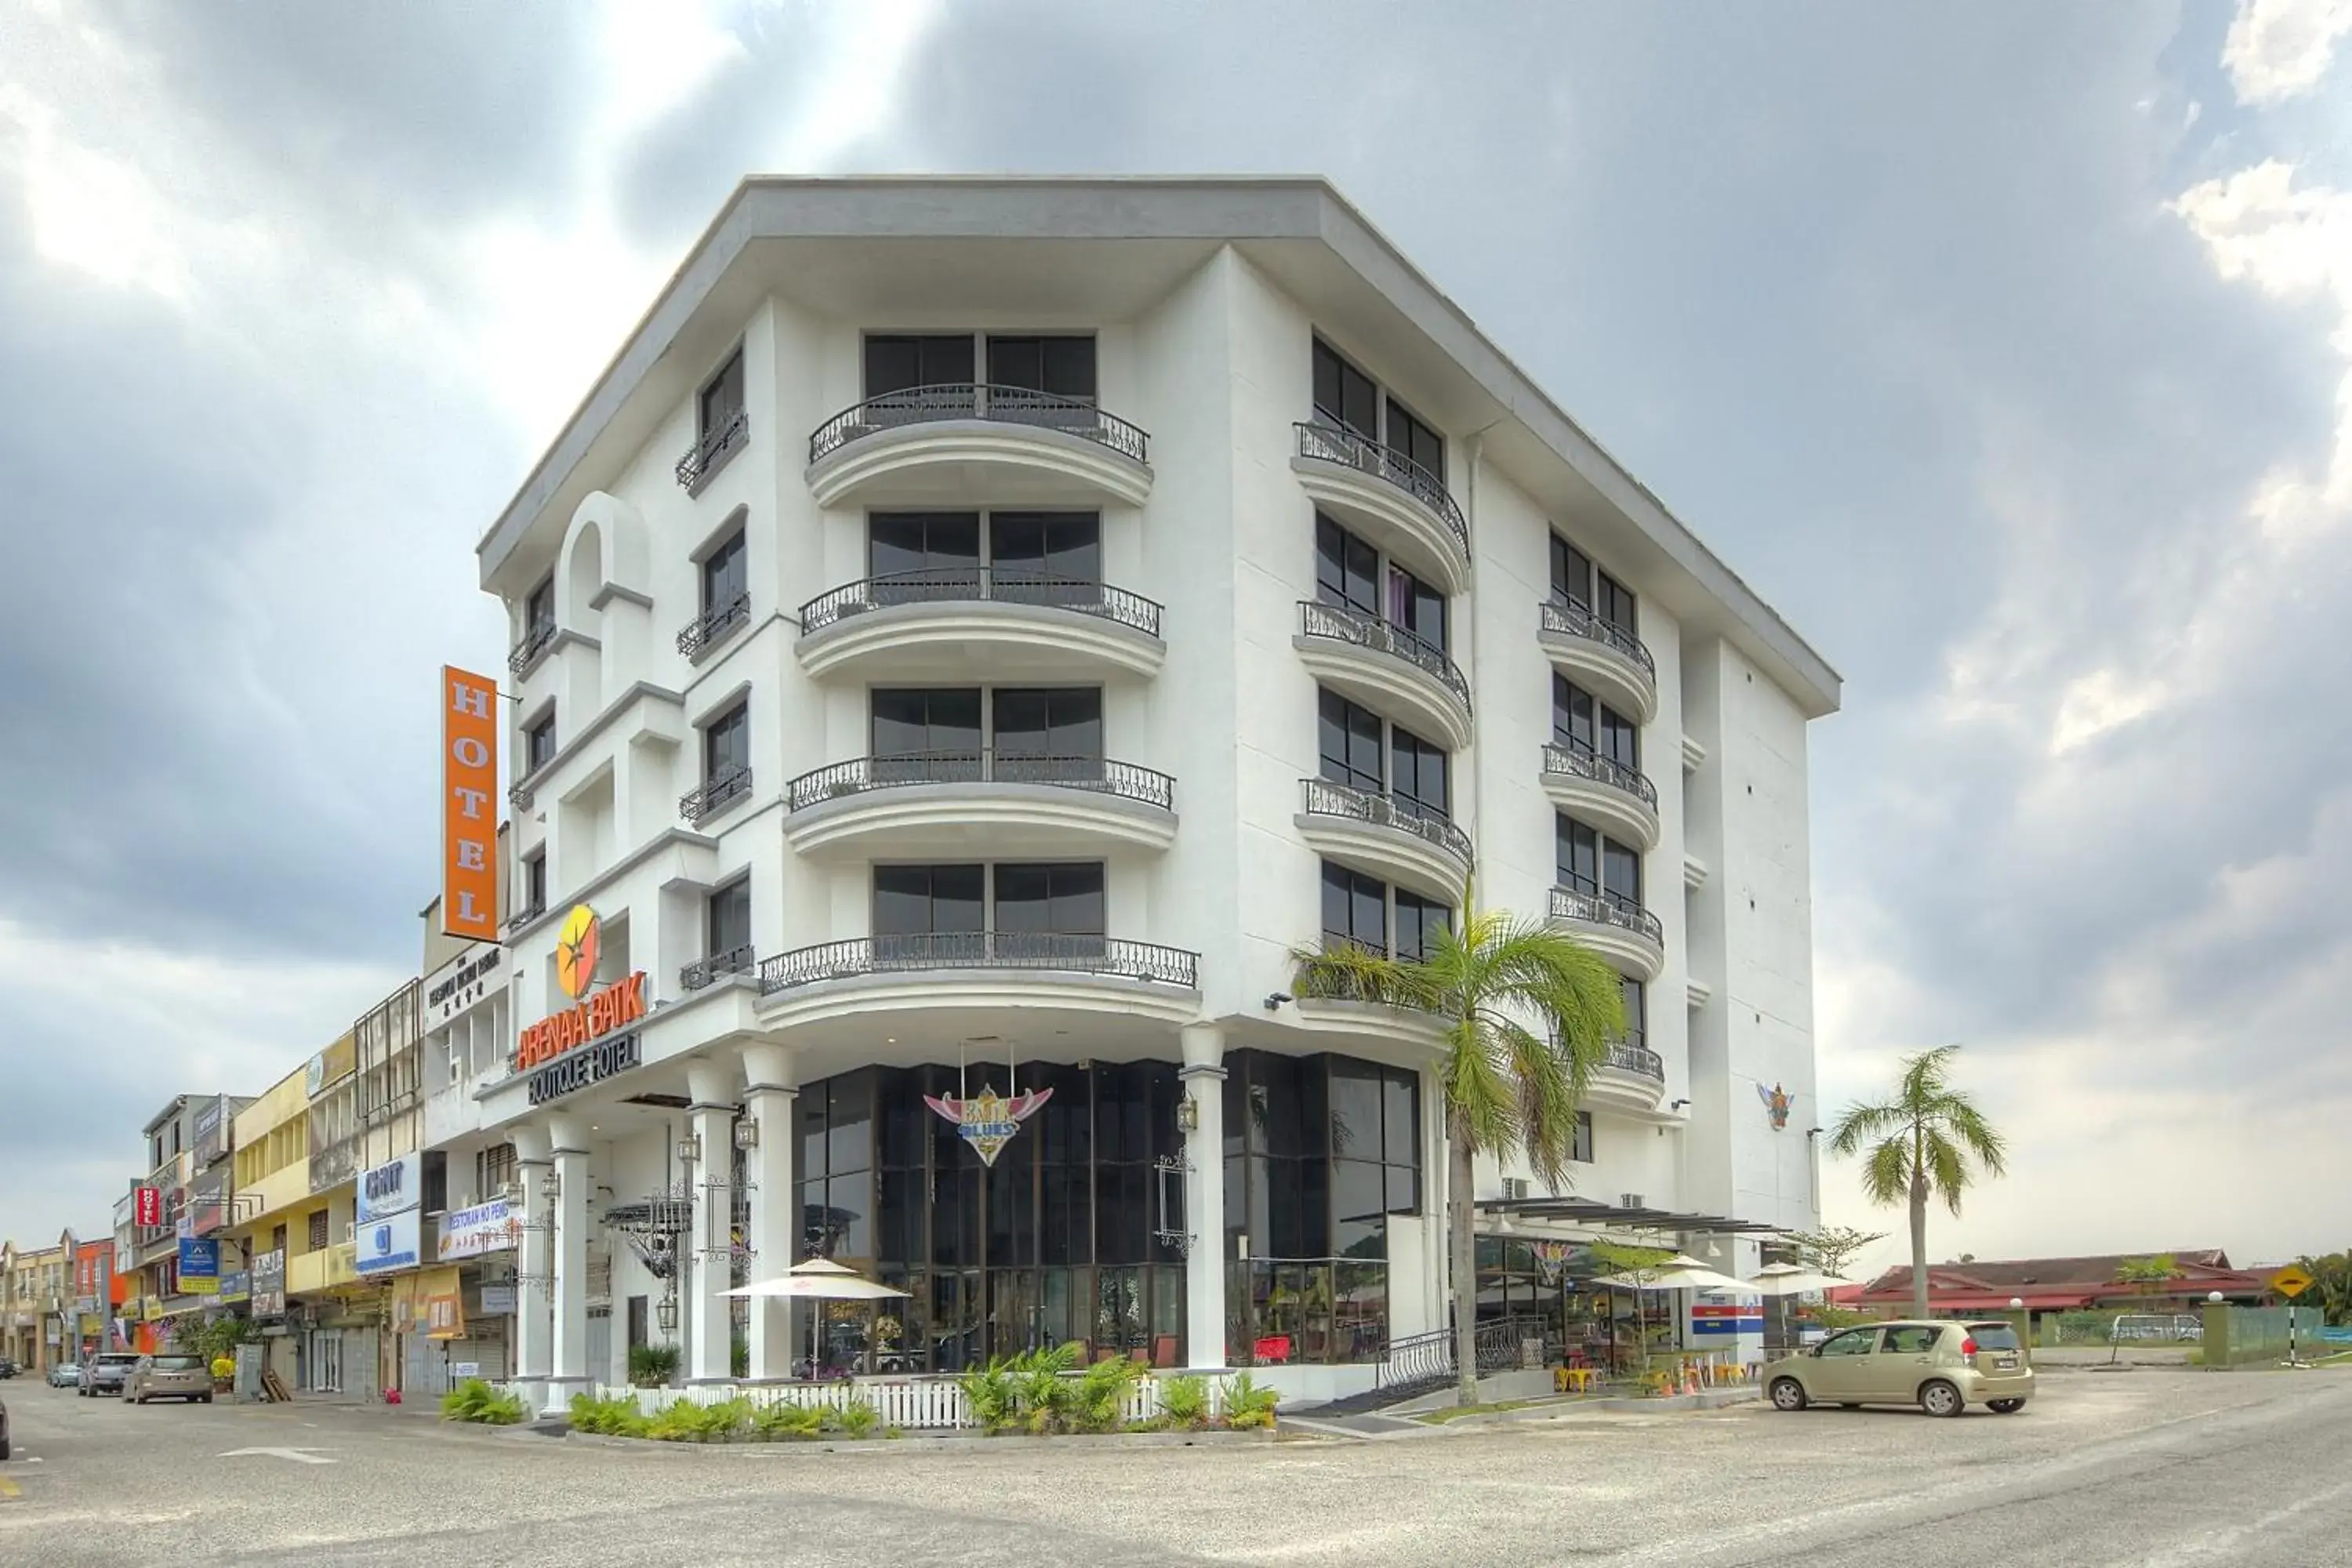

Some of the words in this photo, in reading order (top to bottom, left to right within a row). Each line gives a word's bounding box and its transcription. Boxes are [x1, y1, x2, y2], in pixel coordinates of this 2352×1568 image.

[452, 681, 489, 924] HOTEL
[517, 1002, 590, 1073] ARENAA
[591, 971, 647, 1037] BATIK
[528, 1055, 588, 1105] BOUTIQUE
[590, 1033, 640, 1083] HOTEL
[958, 1123, 1015, 1138] BLUES
